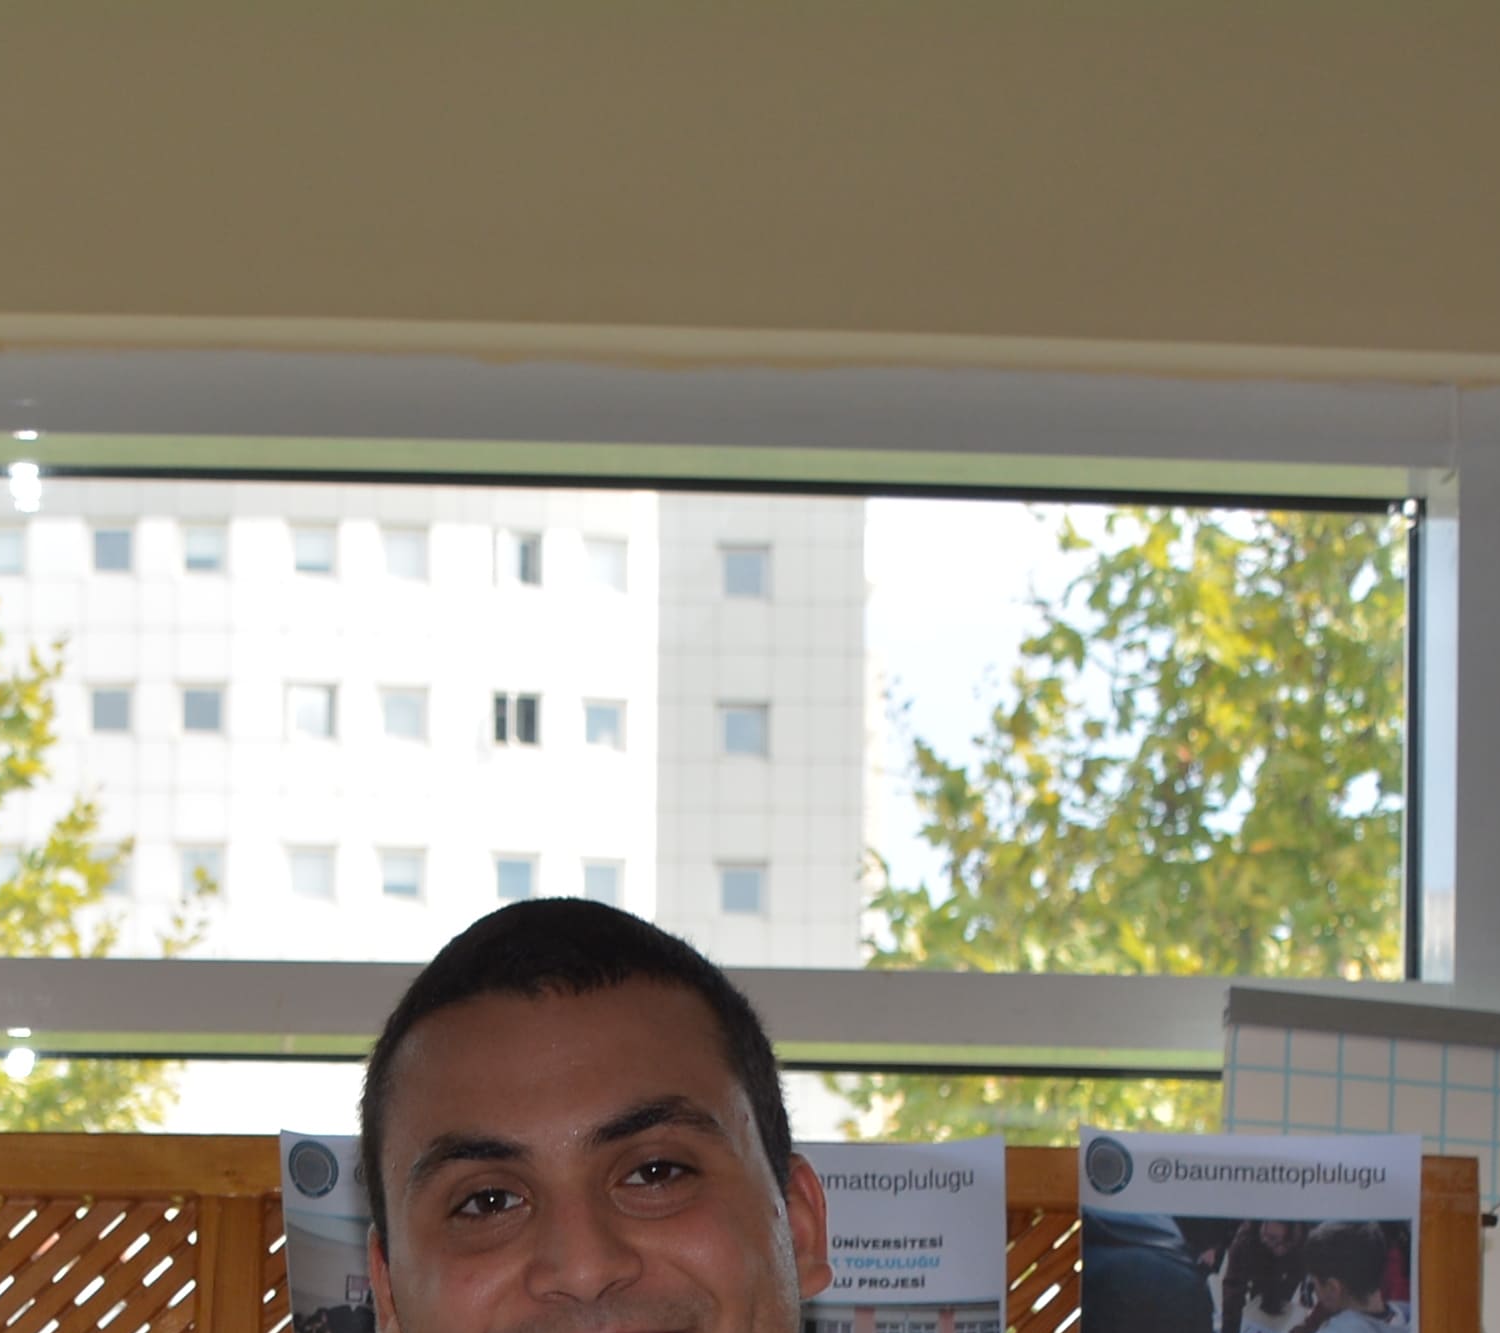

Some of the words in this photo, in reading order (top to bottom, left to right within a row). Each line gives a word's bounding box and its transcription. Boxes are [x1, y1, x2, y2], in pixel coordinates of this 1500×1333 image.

[1148, 1158, 1387, 1190] @baunmattoplulugu
[832, 1234, 944, 1250] ÜNİVERSİTESİ
[845, 1254, 941, 1270] TOPLULUĞU
[858, 1275, 926, 1289] PROJESİ
